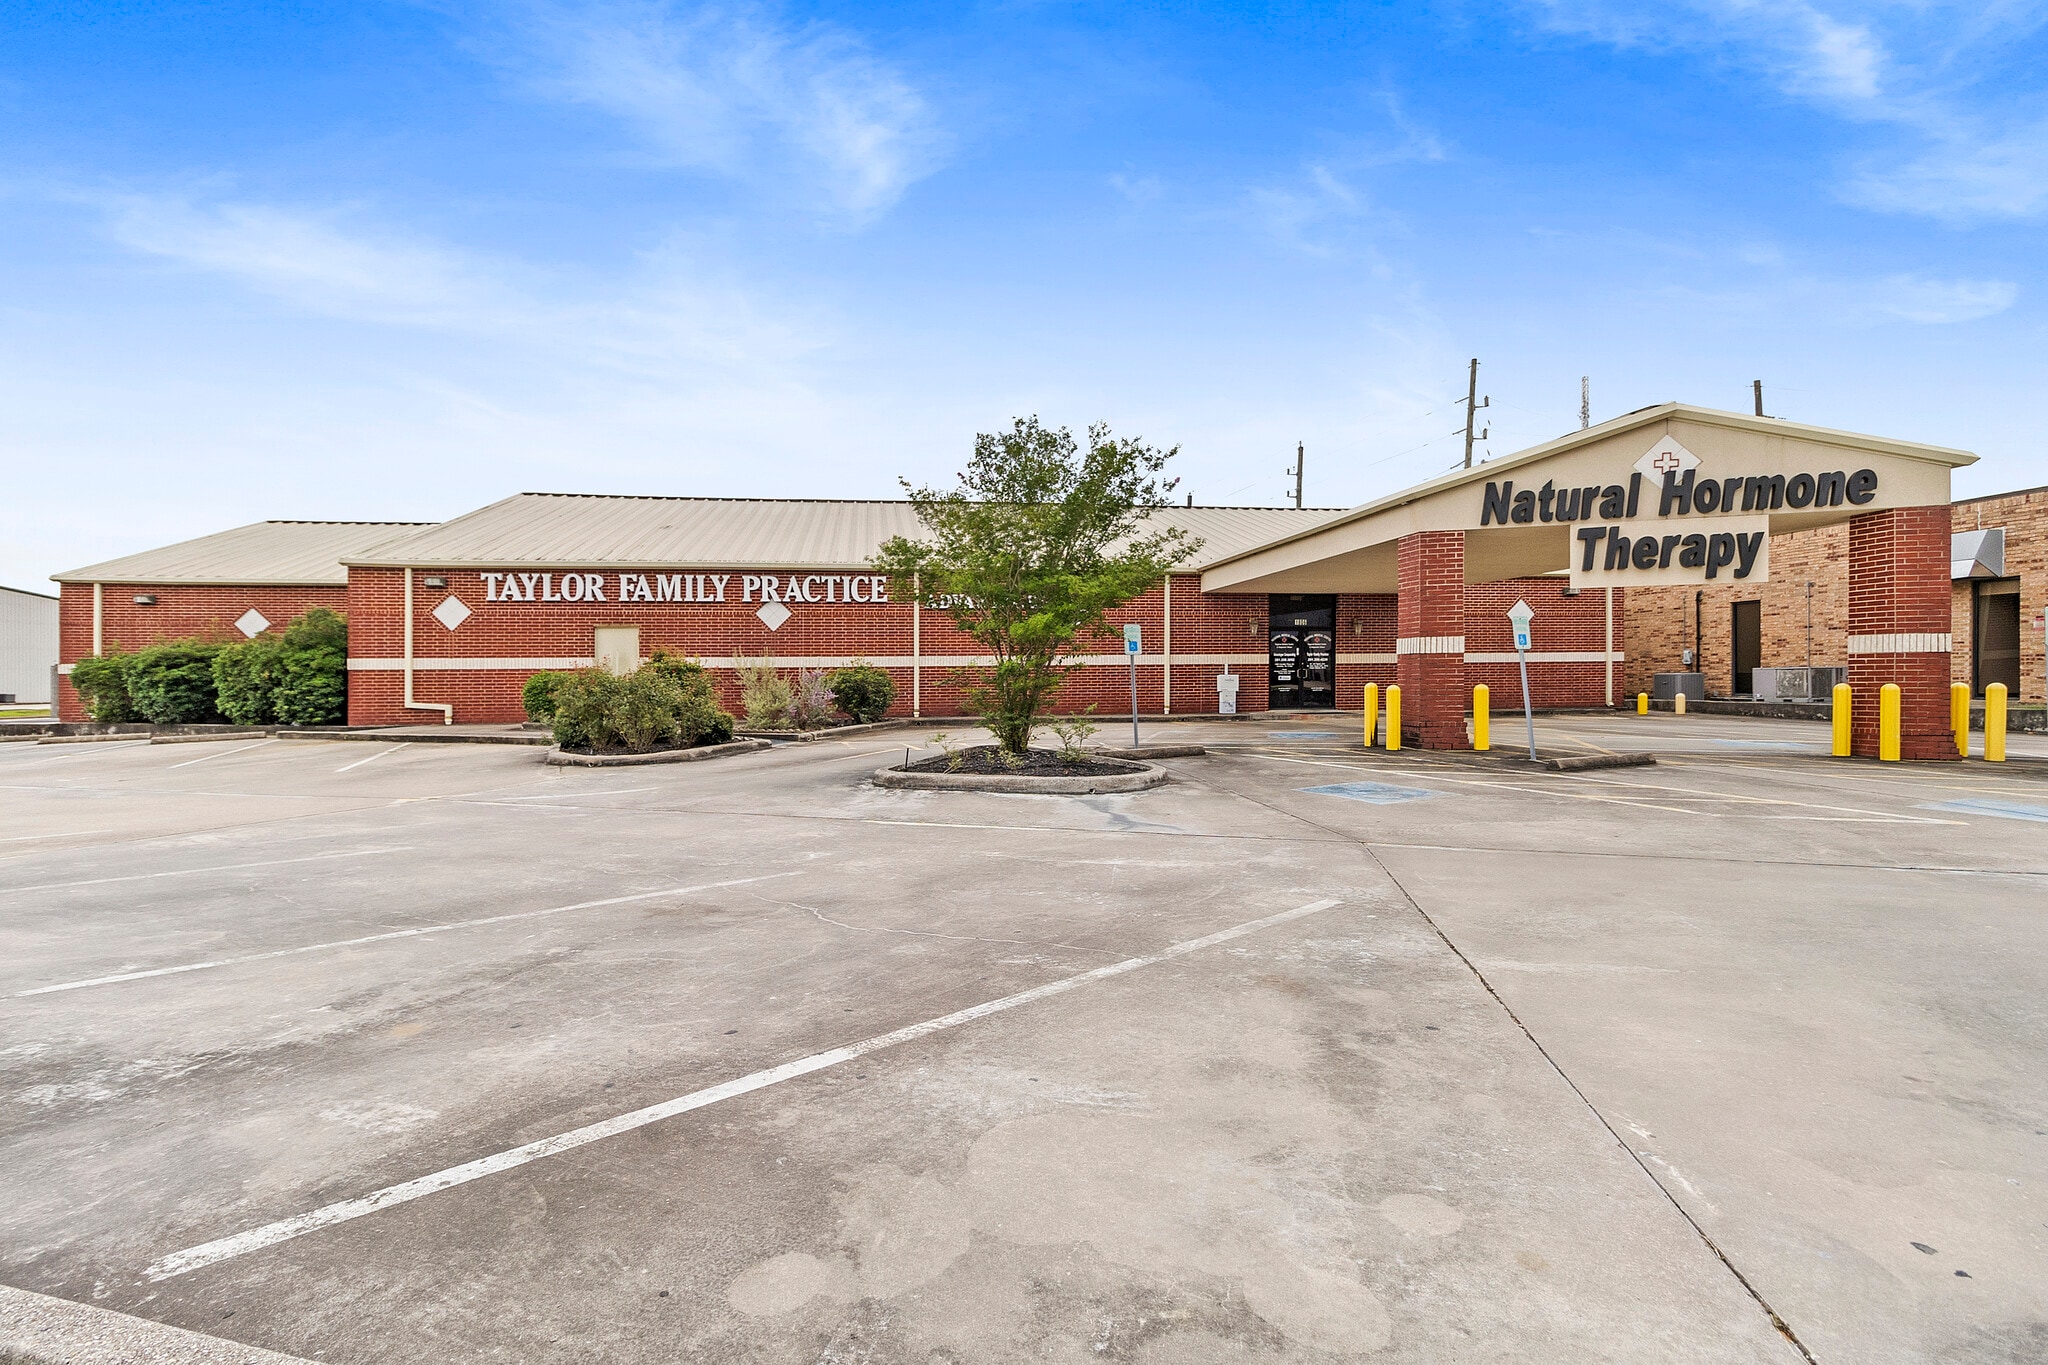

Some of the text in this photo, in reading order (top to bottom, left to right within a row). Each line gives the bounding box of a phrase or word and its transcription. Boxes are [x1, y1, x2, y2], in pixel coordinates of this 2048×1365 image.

[1480, 468, 1878, 526] Natural Hormone
[1576, 526, 1765, 580] Therapy
[480, 572, 888, 603] TAYLOR FAMILY PRACTICE
